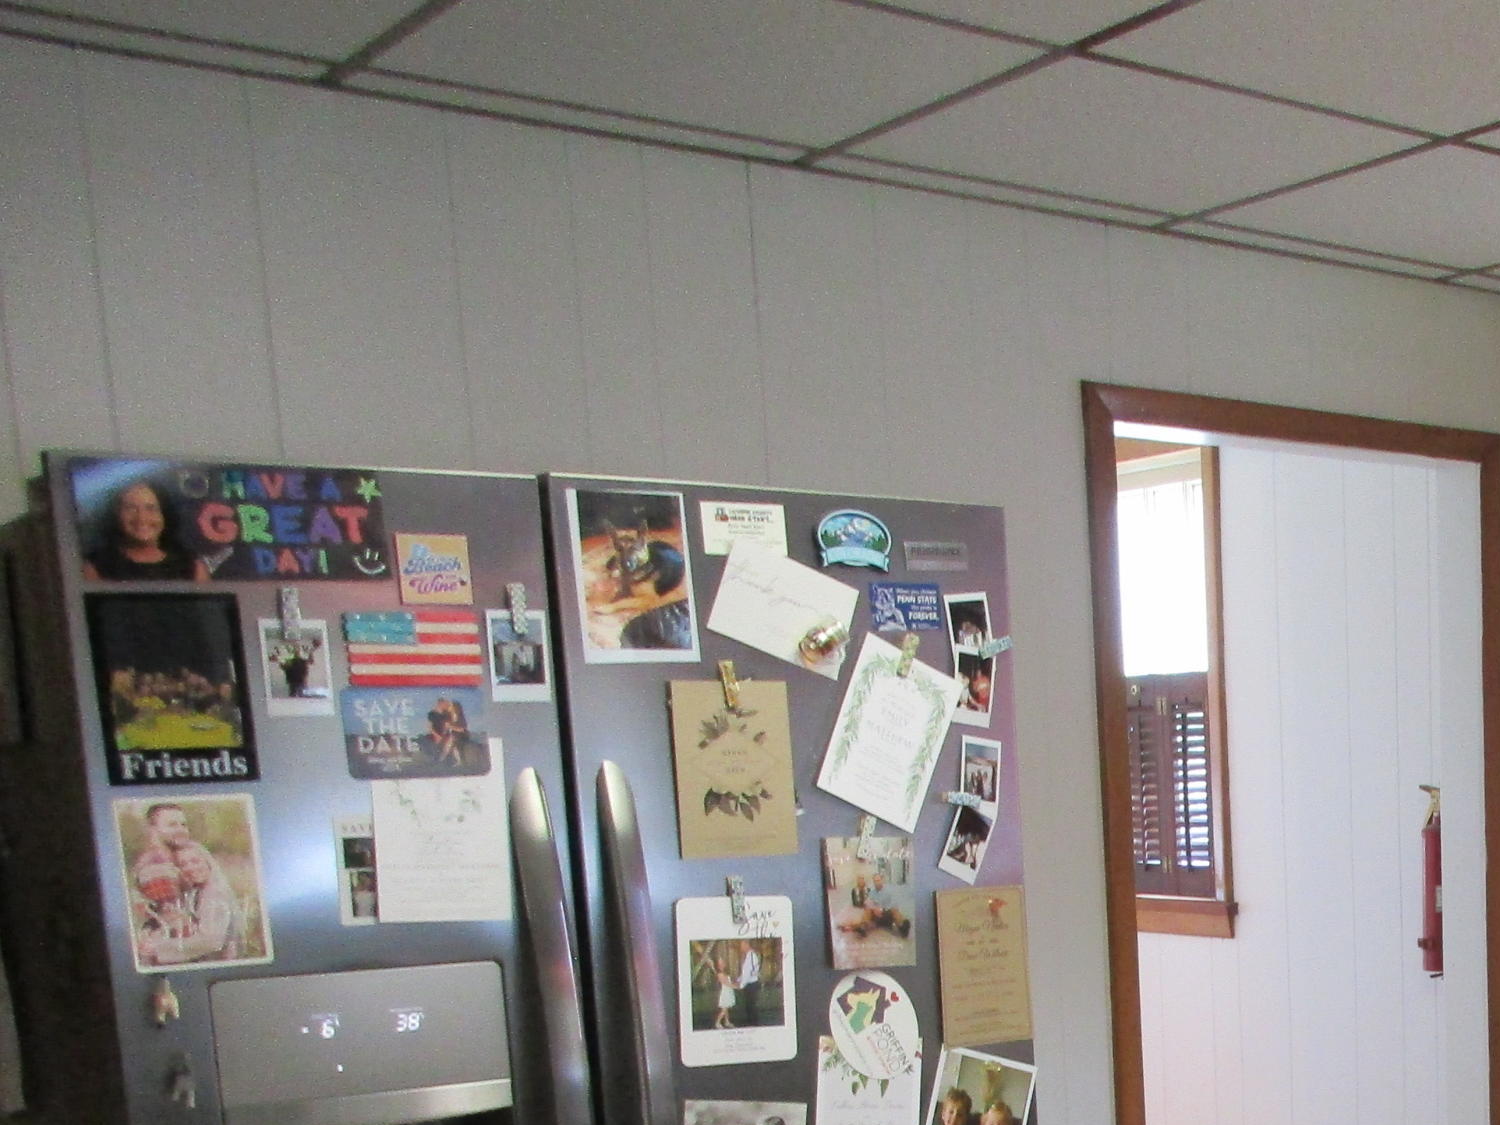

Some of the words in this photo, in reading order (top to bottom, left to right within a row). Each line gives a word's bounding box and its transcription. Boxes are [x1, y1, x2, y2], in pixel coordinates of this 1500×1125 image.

[222, 471, 306, 500] HAVE
[320, 477, 341, 501] A
[198, 503, 369, 544] GREAT
[897, 594, 916, 603] PENN
[917, 595, 937, 604] STATE
[354, 699, 415, 717] SAVE
[361, 717, 410, 735] THE
[359, 735, 421, 754] DATE
[121, 750, 249, 780] Friends
[881, 1023, 909, 1066] GRIFFIN
